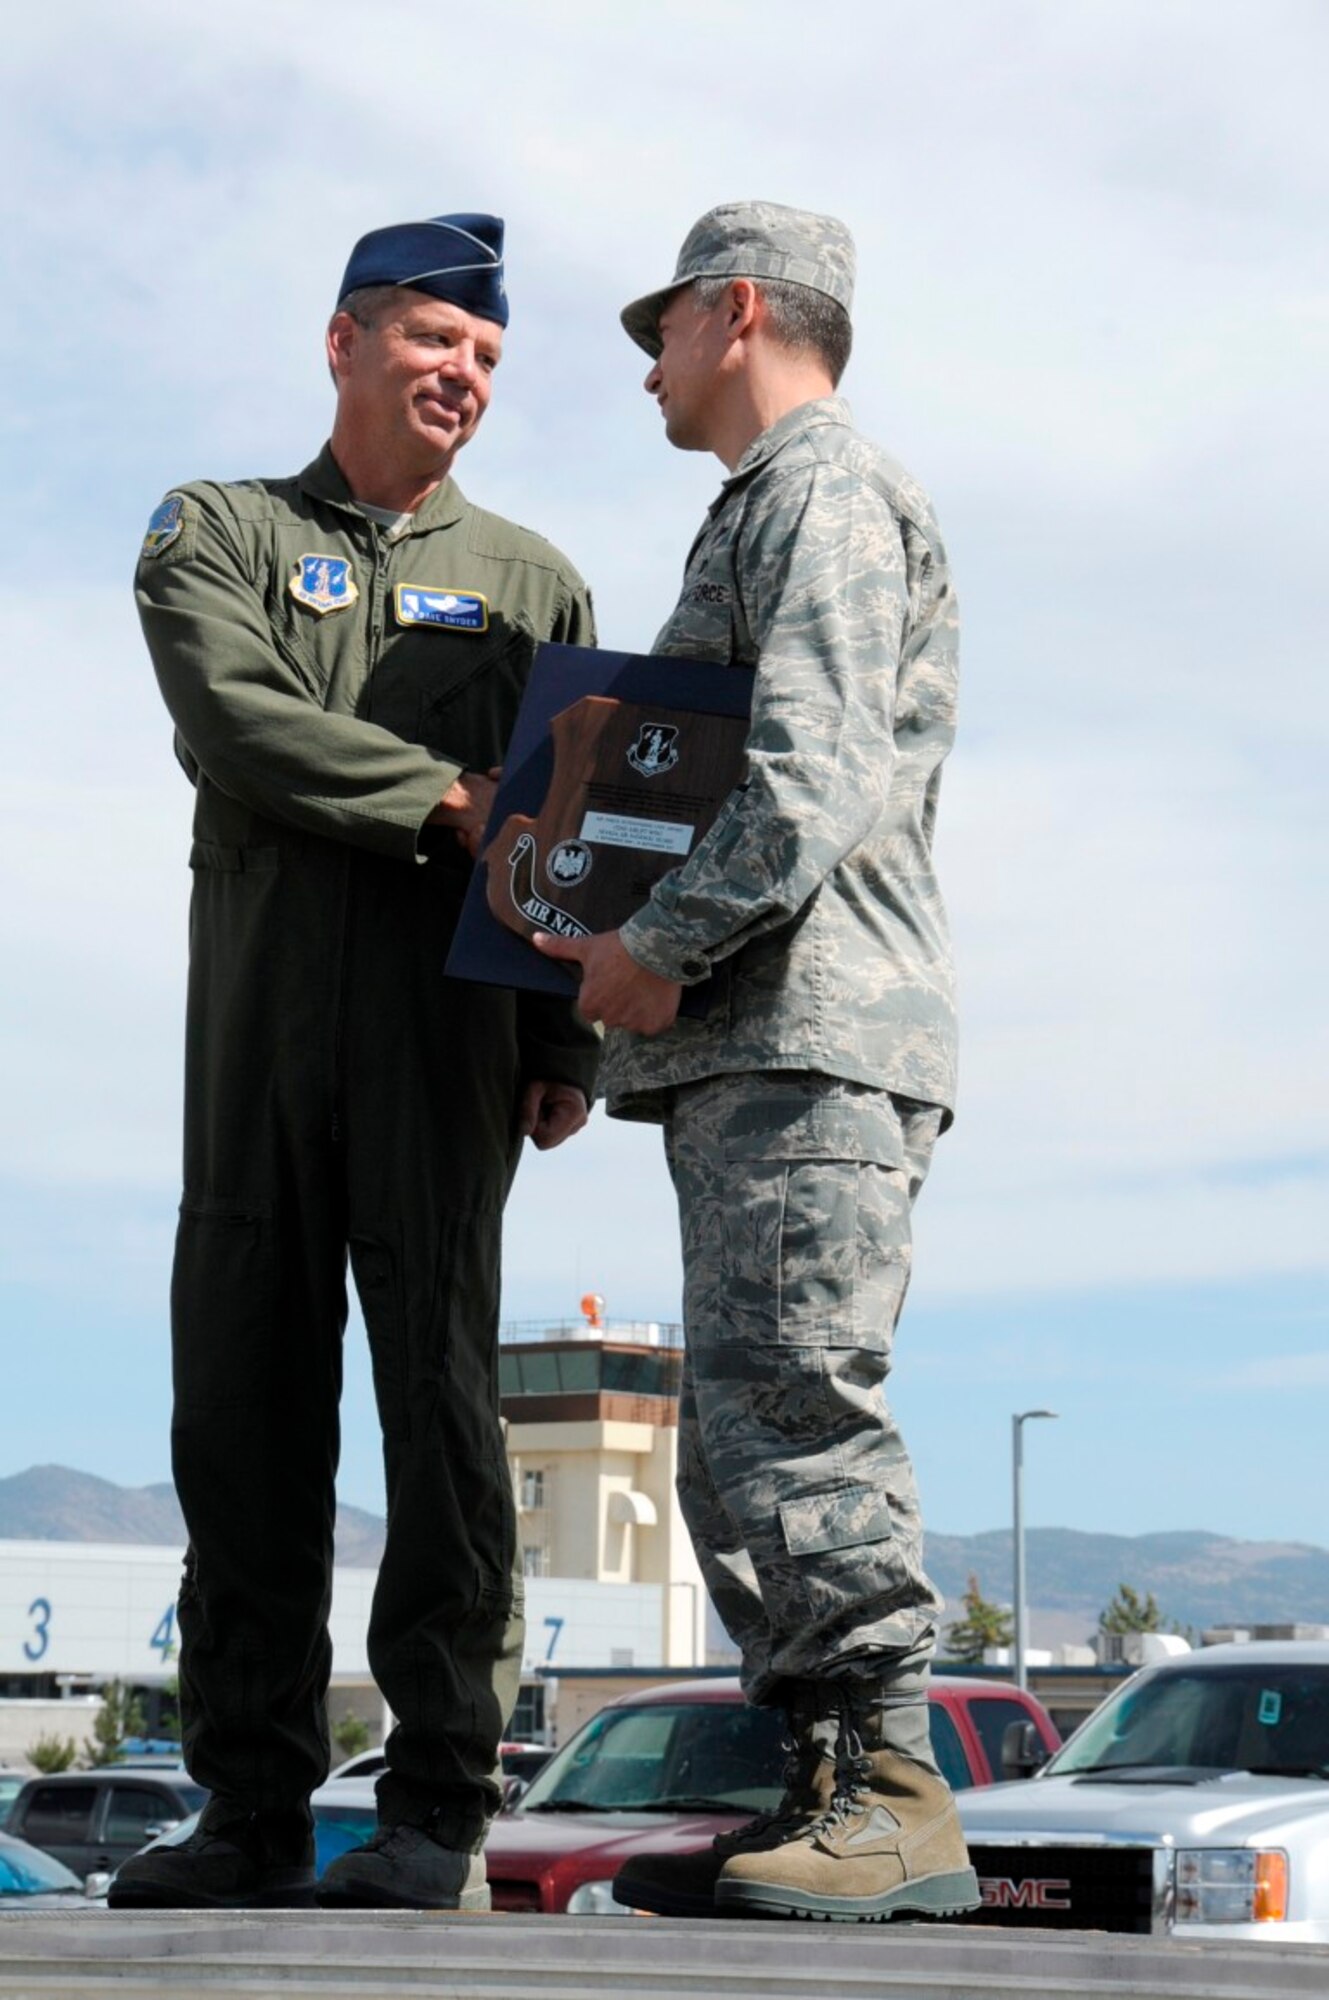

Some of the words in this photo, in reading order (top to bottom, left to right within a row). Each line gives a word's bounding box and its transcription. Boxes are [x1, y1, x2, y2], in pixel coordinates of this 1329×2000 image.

[522, 898, 550, 922] AIR
[551, 912, 586, 939] NAT
[24, 1597, 51, 1661] 3
[150, 1602, 175, 1663] 4
[544, 1617, 564, 1661] 7
[979, 1877, 1072, 1909] GMC
